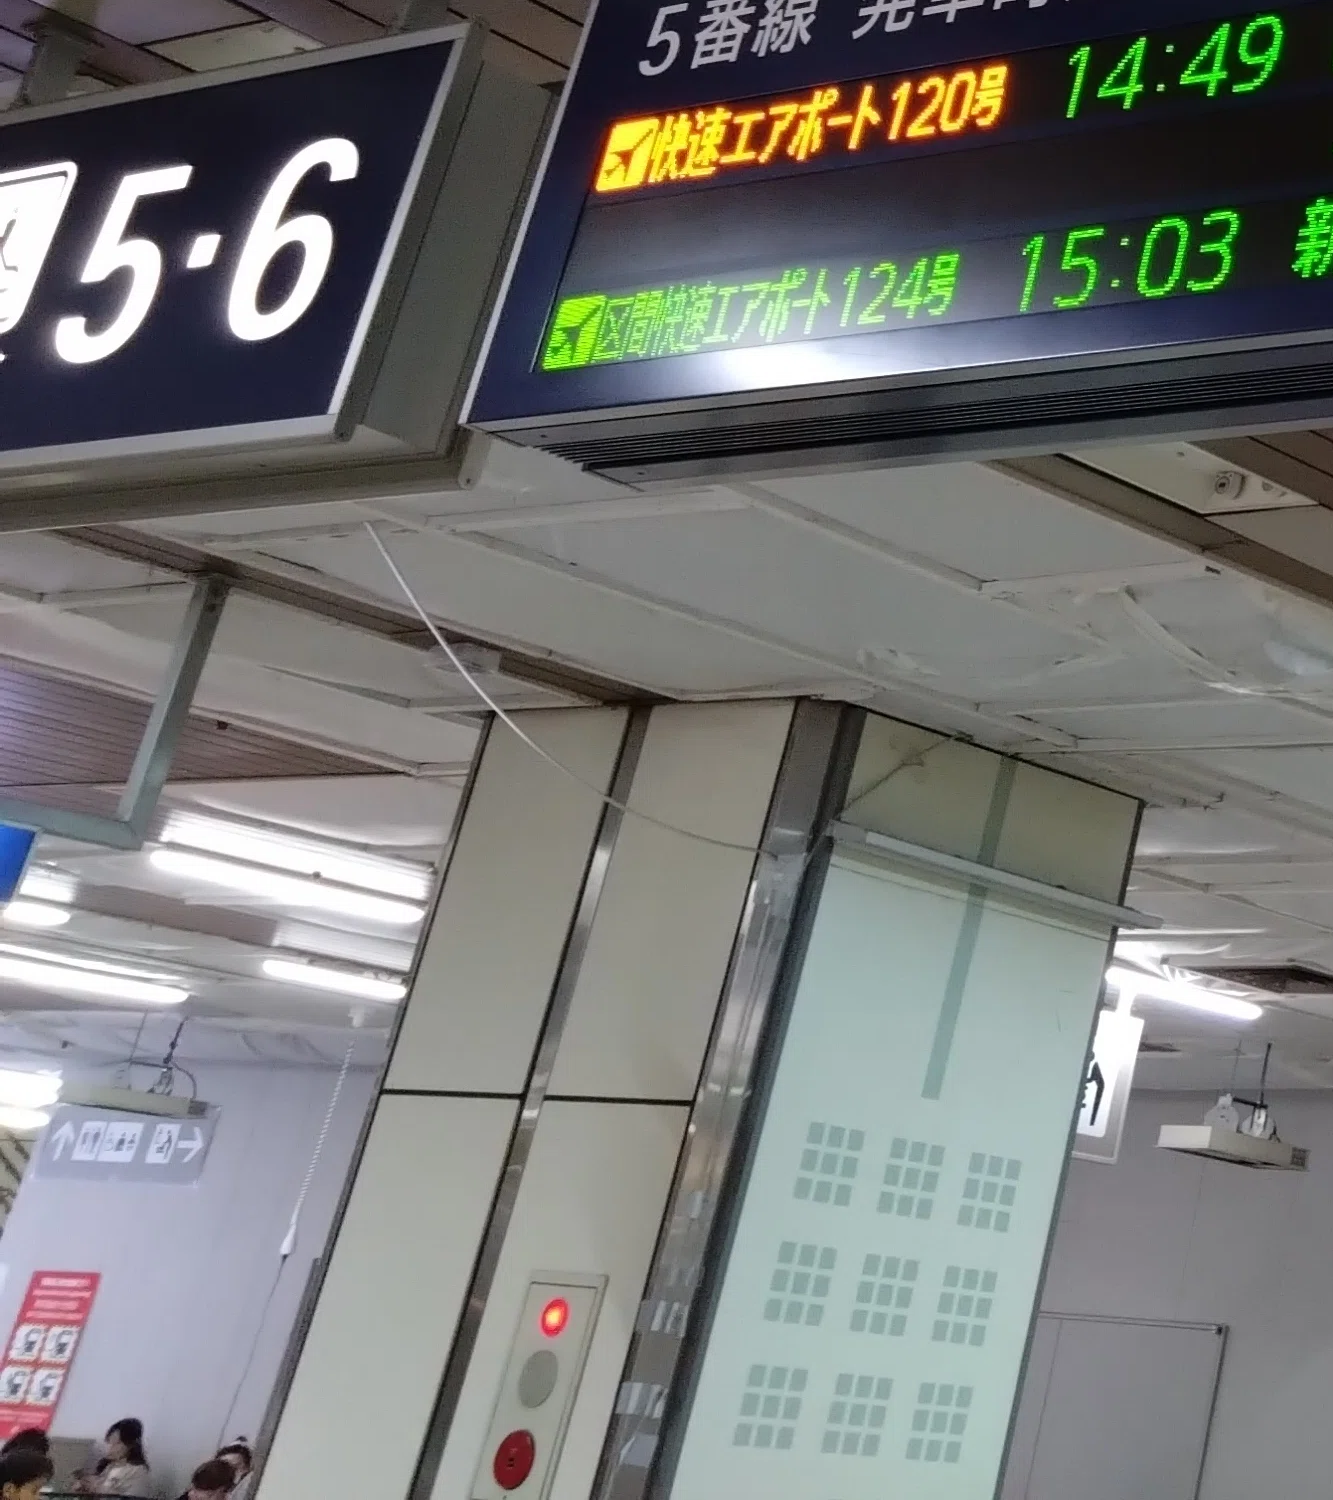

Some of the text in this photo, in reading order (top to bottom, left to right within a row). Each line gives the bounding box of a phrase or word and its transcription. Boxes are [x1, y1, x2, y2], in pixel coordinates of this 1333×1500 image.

[650, 64, 1008, 185] 快速エアポート120号
[1066, 15, 1284, 119] 14:49
[596, 252, 961, 363] 区間快速エアポート124号
[1019, 210, 1240, 312] 15:03
